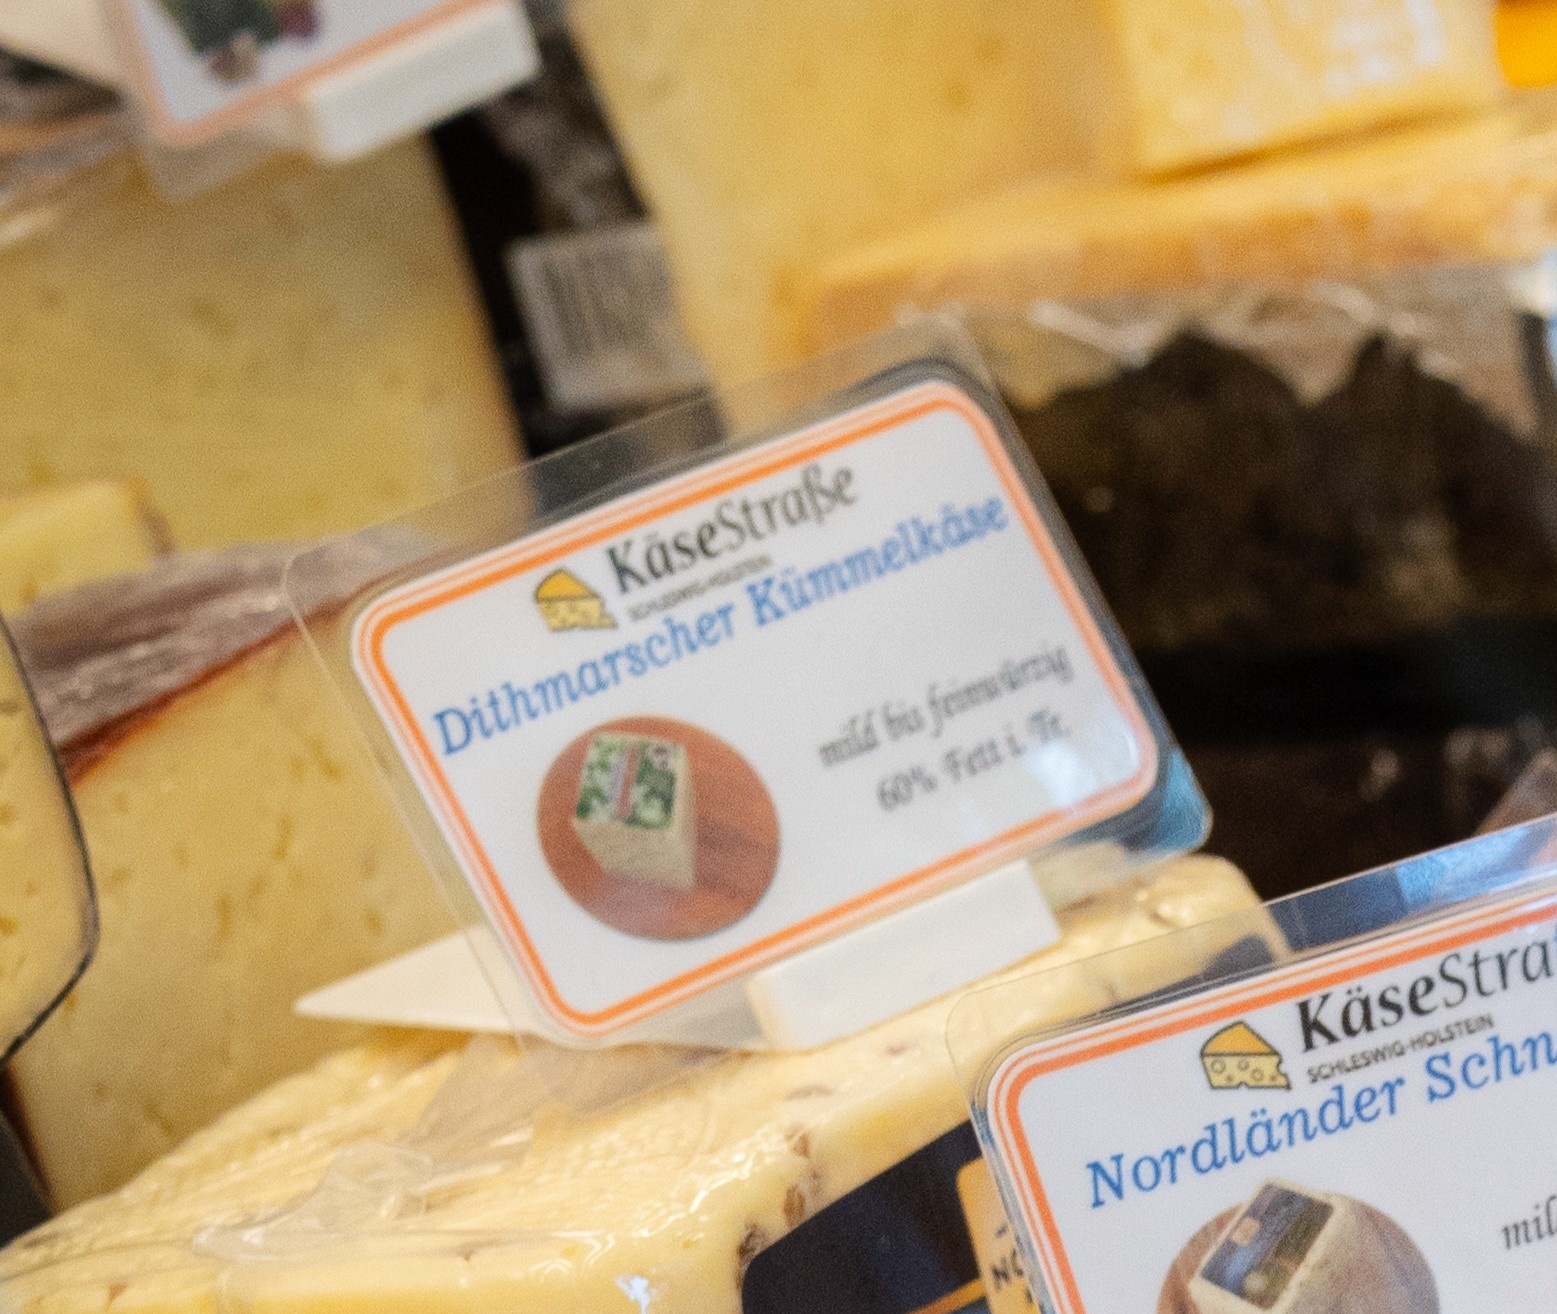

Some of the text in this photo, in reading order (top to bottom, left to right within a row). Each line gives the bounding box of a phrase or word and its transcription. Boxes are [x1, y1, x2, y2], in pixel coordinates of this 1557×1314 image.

[605, 463, 857, 594] KäseStraße
[433, 497, 1010, 757] Dithmarscher Kümmelkäse
[818, 708, 881, 769] mild
[881, 700, 926, 742] bis
[876, 765, 939, 812] 60%
[942, 738, 1003, 783] Fett
[1307, 1013, 1495, 1084] SCHLESWIG-HOLSTEIN
[1086, 1076, 1406, 1209] Nordländer
